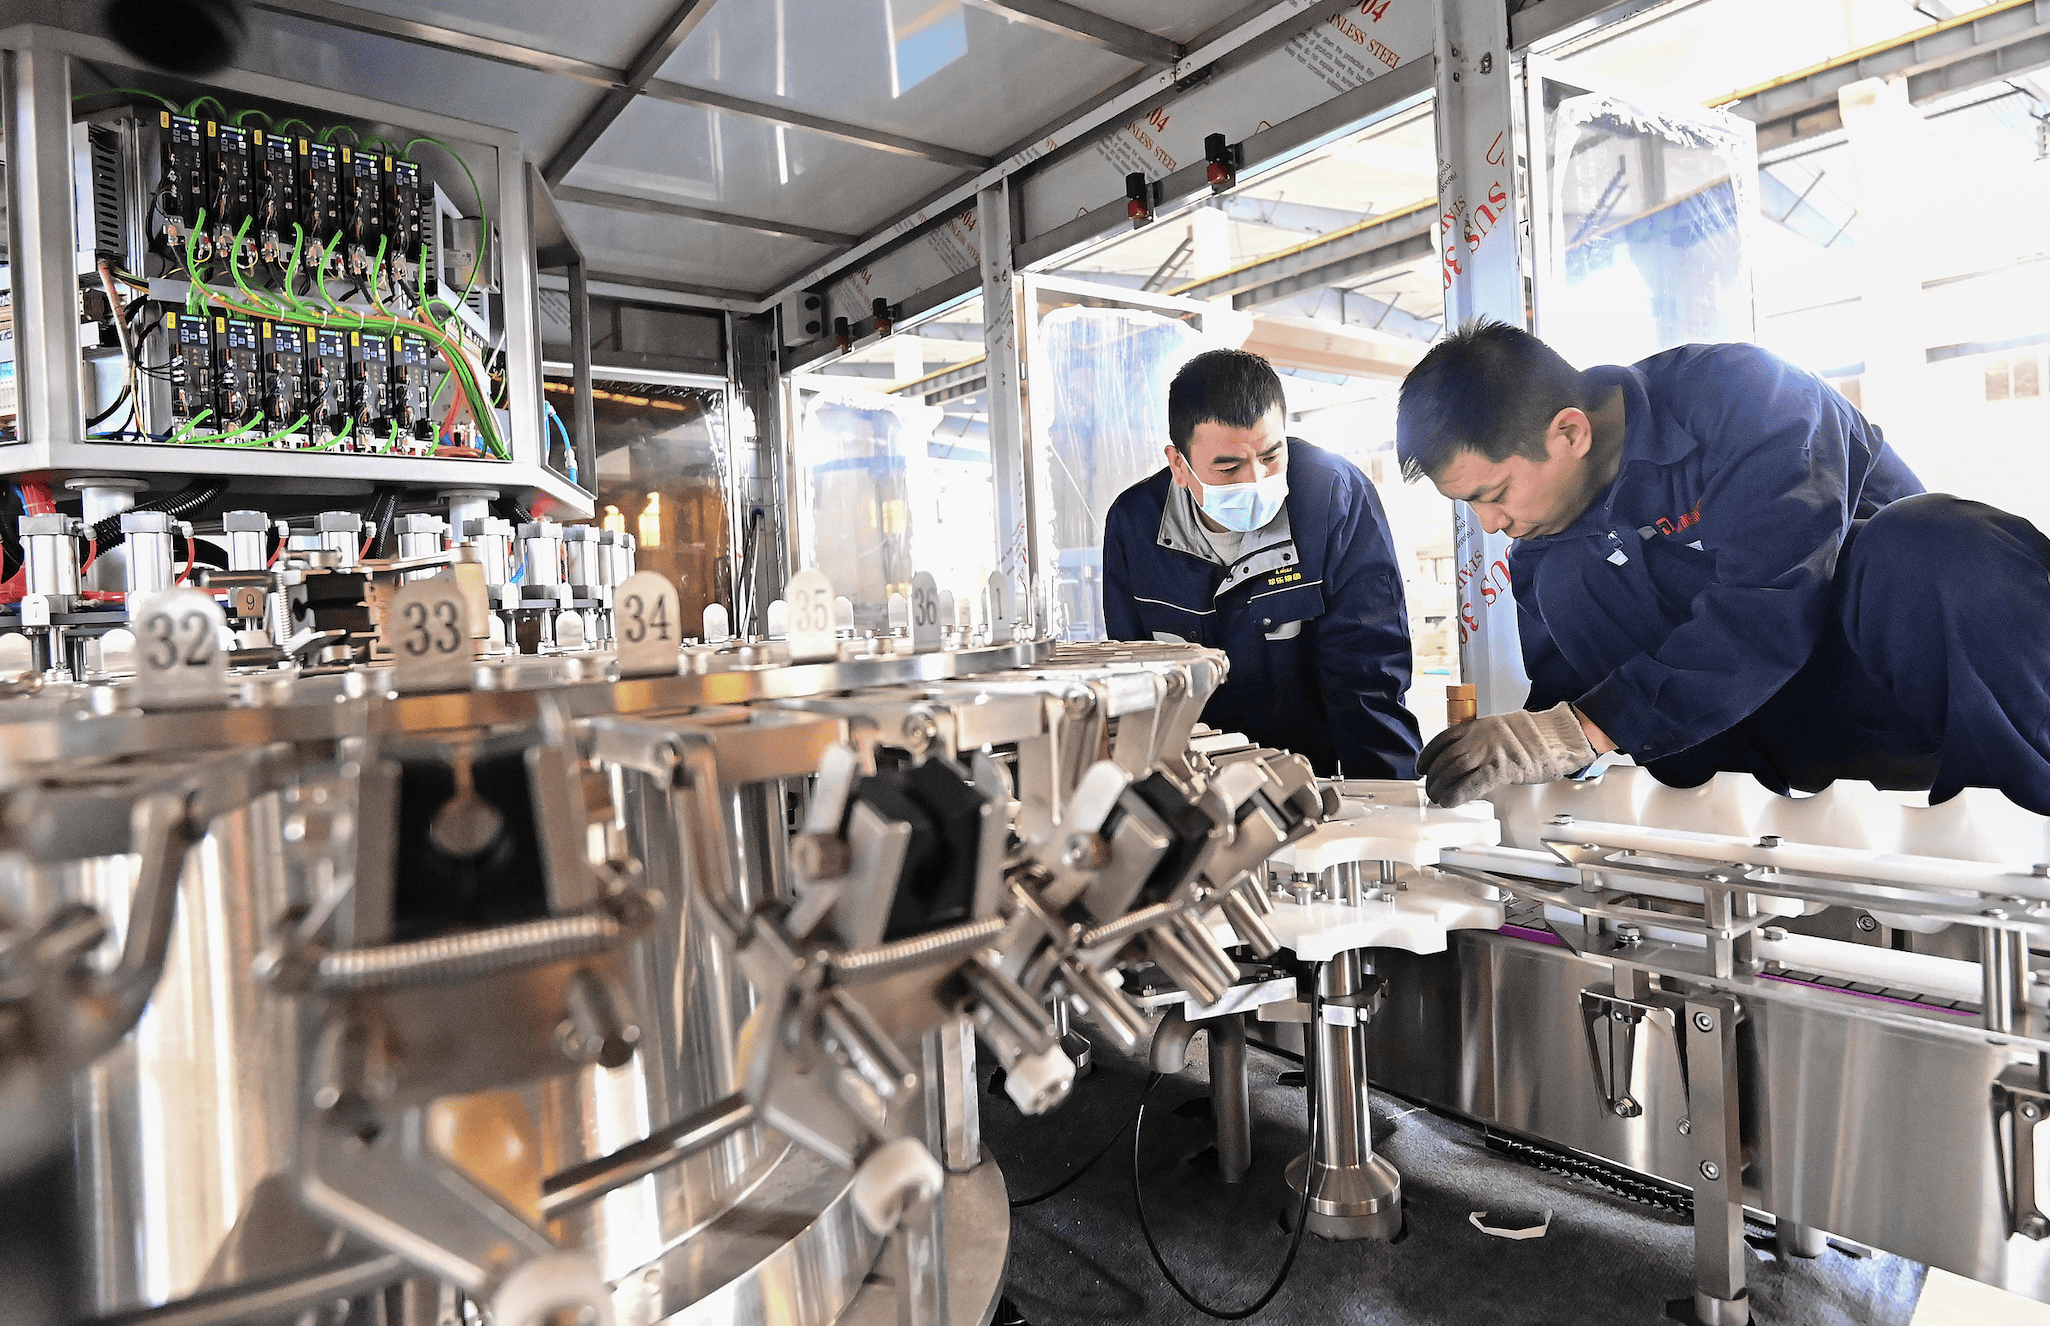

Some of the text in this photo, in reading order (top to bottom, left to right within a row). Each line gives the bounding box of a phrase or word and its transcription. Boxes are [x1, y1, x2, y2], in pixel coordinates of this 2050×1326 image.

[1143, 107, 1170, 133] 04
[1463, 180, 1507, 255] SUS
[246, 594, 255, 611] 9
[625, 594, 672, 643] 34
[795, 588, 828, 632] 35
[914, 586, 938, 626] 36
[995, 587, 1003, 620] 1
[147, 611, 209, 670] 32
[404, 600, 462, 657] 33
